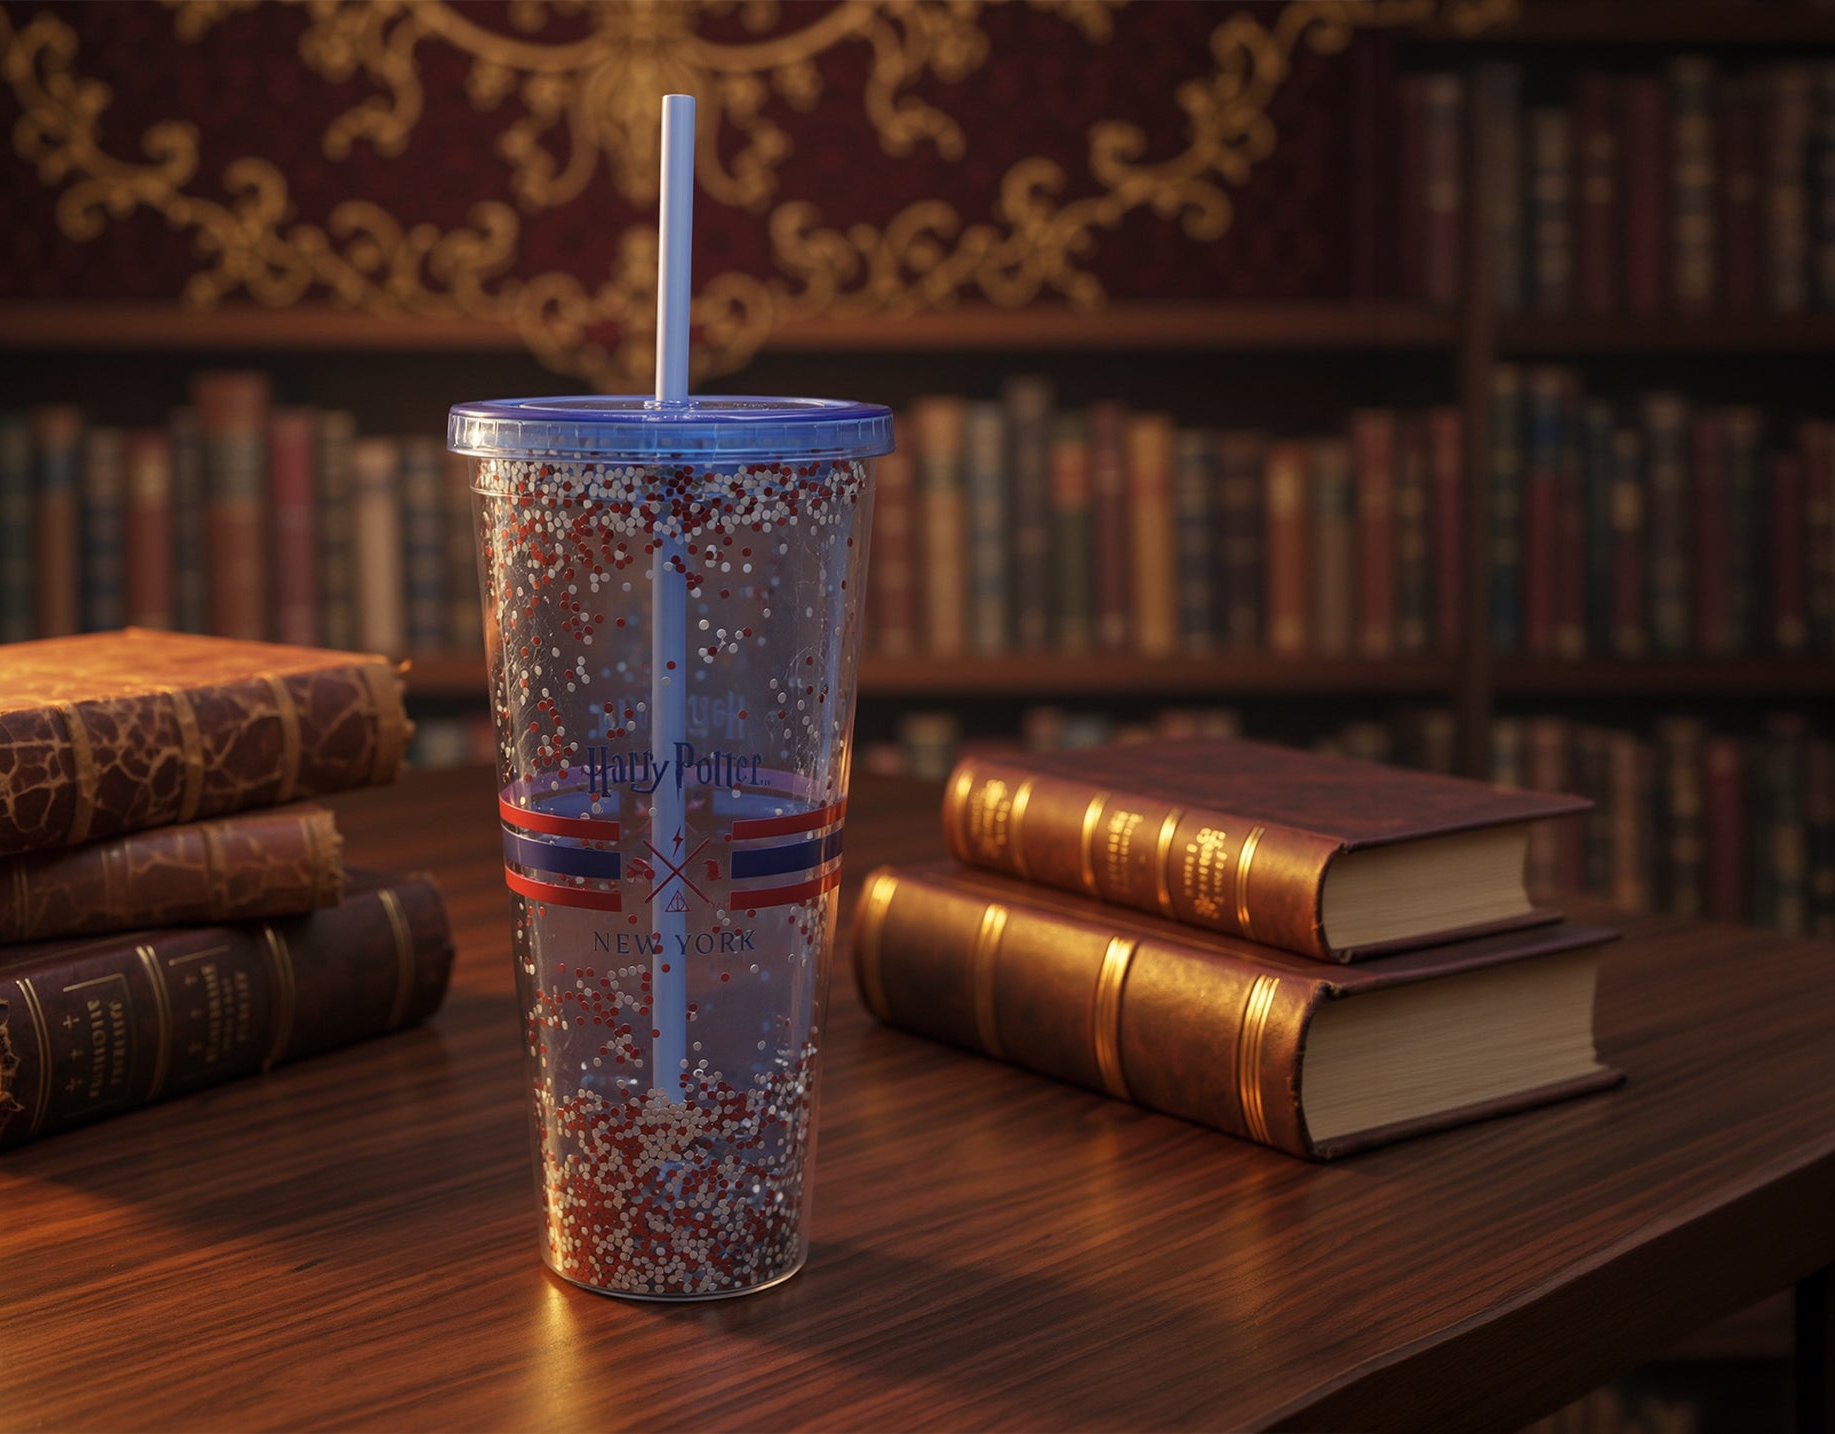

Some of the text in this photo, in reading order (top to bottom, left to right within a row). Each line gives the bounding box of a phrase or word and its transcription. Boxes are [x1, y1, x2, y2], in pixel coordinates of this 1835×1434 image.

[581, 741, 762, 800] Harry Potter
[593, 929, 757, 956] NEW YORK
